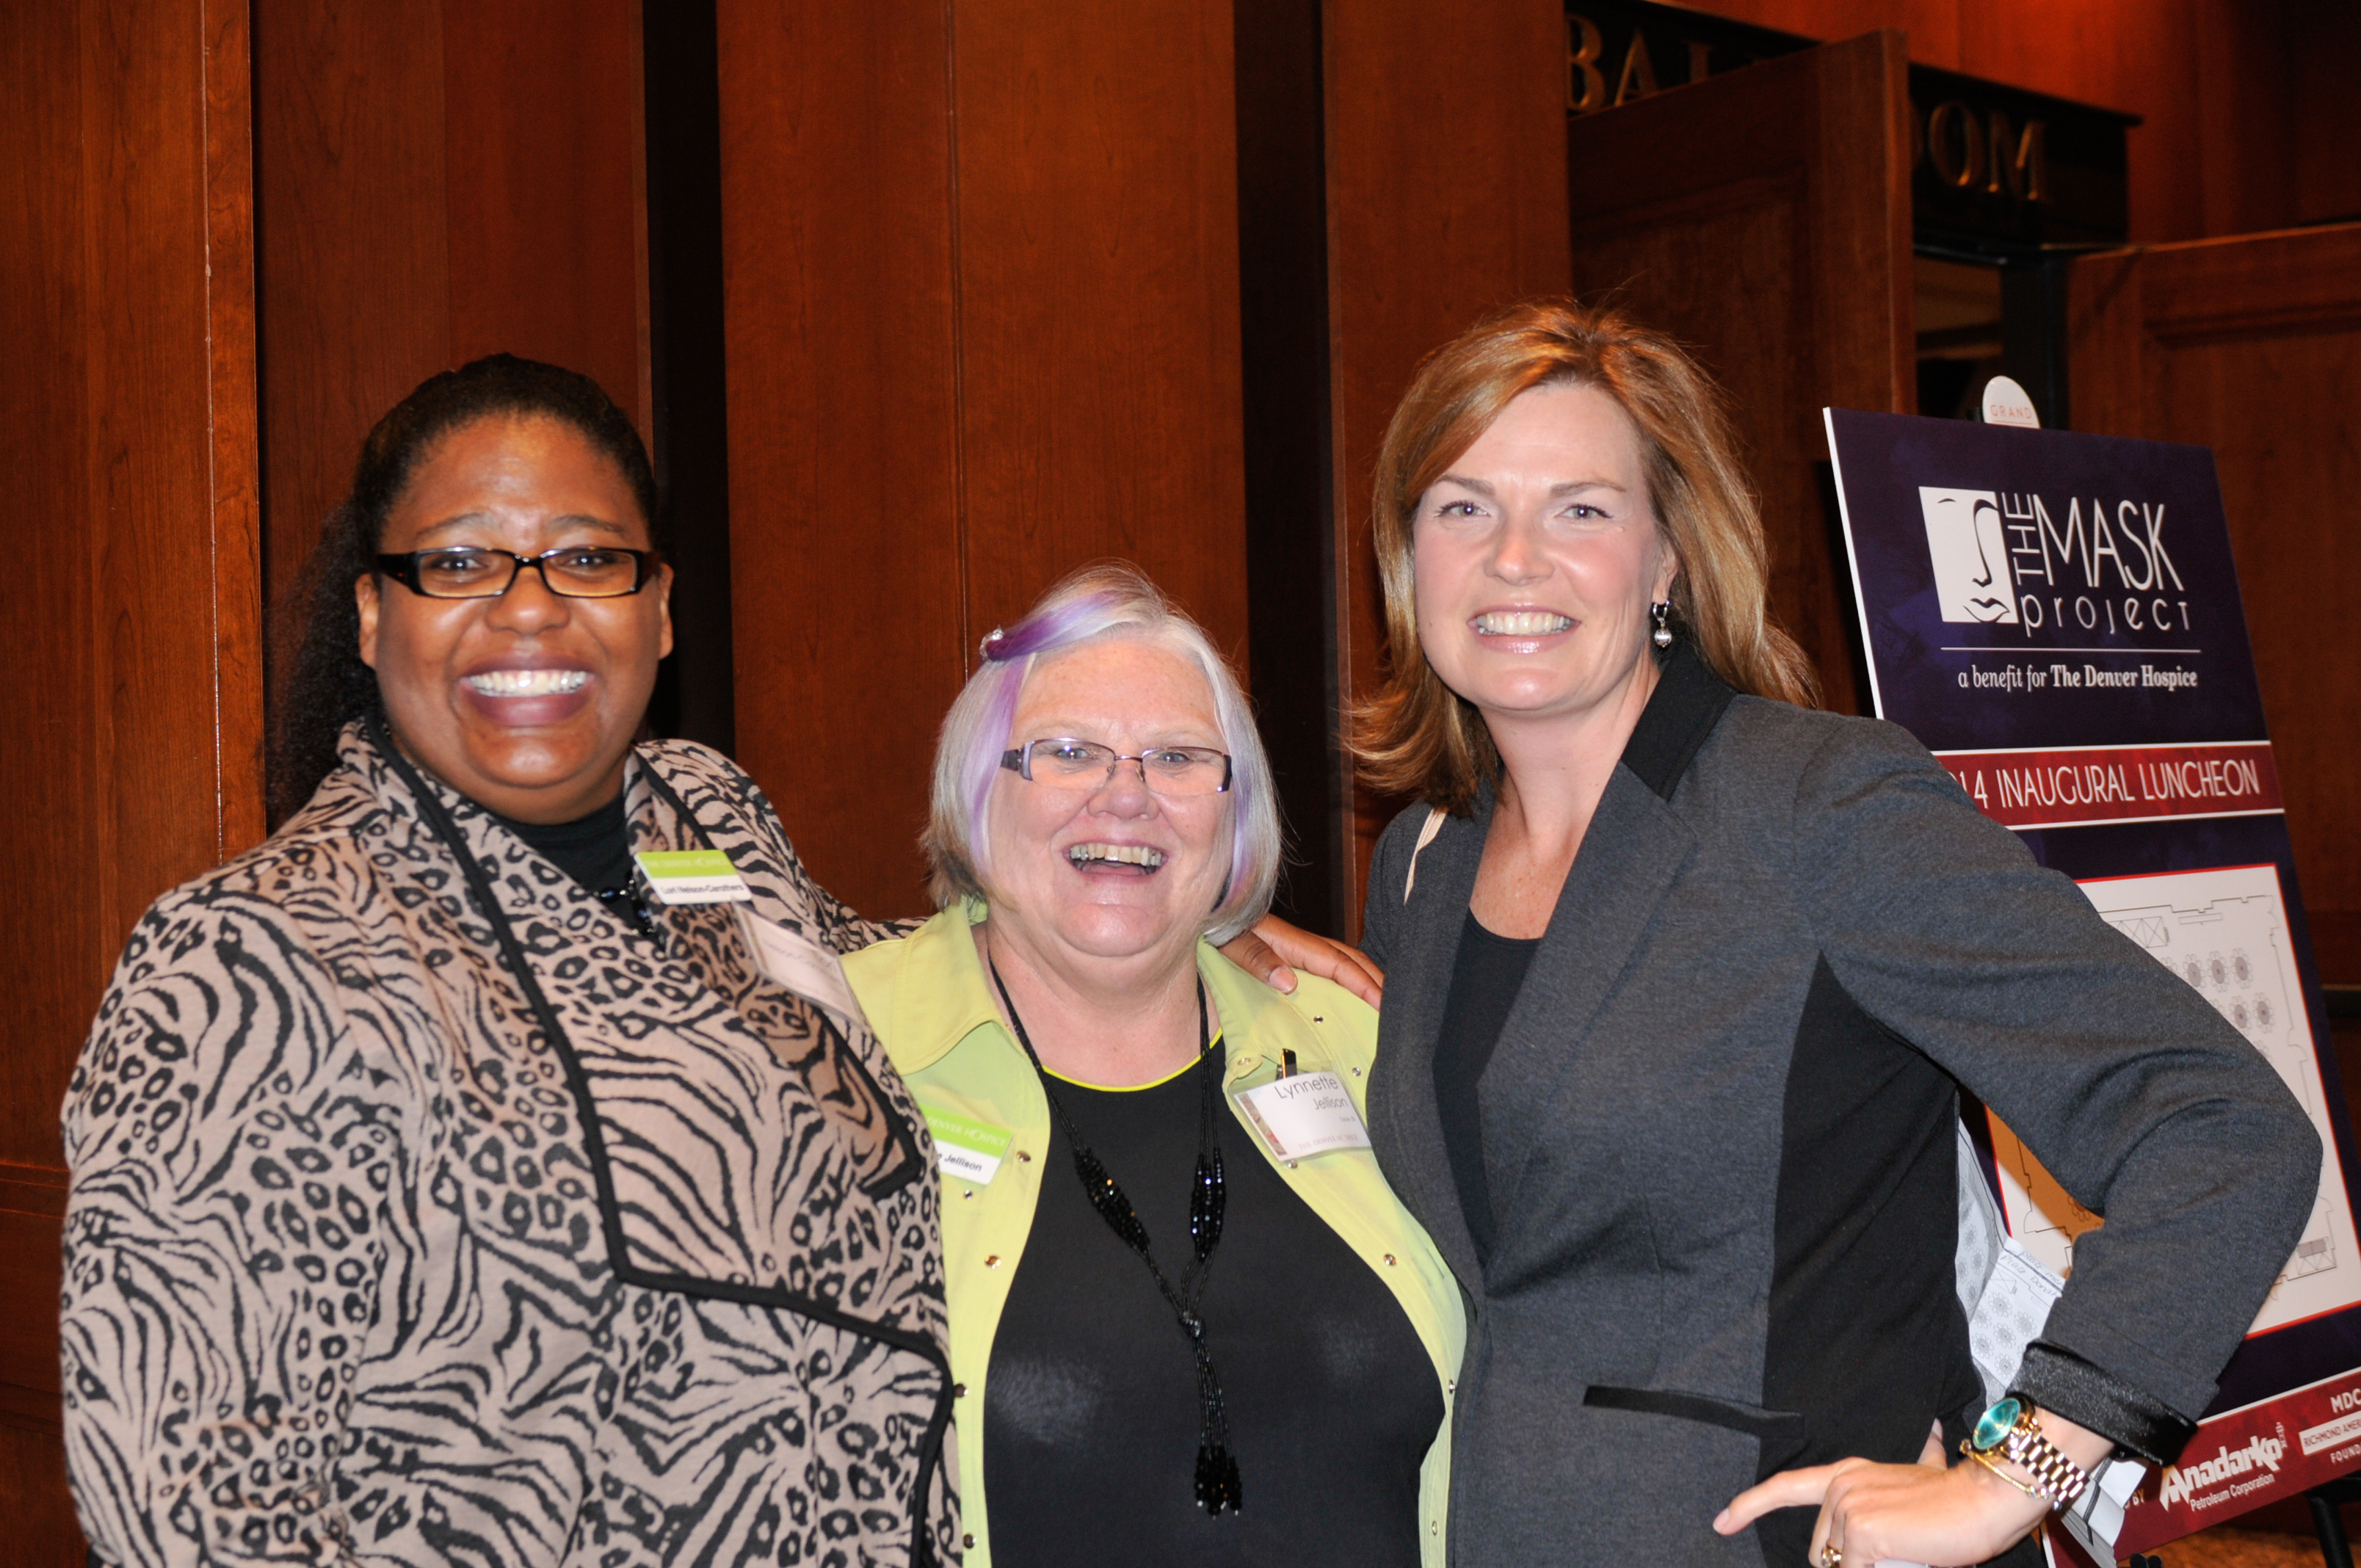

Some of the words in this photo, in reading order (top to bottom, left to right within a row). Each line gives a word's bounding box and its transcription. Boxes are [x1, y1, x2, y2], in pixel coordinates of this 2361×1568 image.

[1990, 404, 2033, 419] GRAND
[2001, 492, 2045, 586] THE
[2032, 494, 2185, 592] MASK
[1958, 671, 1968, 688] a
[1971, 664, 2023, 692] benefit
[2026, 664, 2048, 692] for
[2050, 664, 2081, 688] The
[2083, 664, 2139, 688] Denver
[2141, 664, 2198, 692] Hospice
[1995, 763, 2136, 808] INAUGURAL
[2138, 758, 2260, 800] LUNCHEON
[1274, 1075, 1338, 1100] Lynnette
[1313, 1096, 1349, 1110] Jellison
[927, 1116, 962, 1135] DENVER
[944, 1155, 982, 1172] Jellison
[2330, 1442, 2361, 1464] FOUND
[2159, 1435, 2282, 1511] Anadarko
[2190, 1489, 2230, 1511] Petroleum
[2229, 1473, 2275, 1498] Corporation
